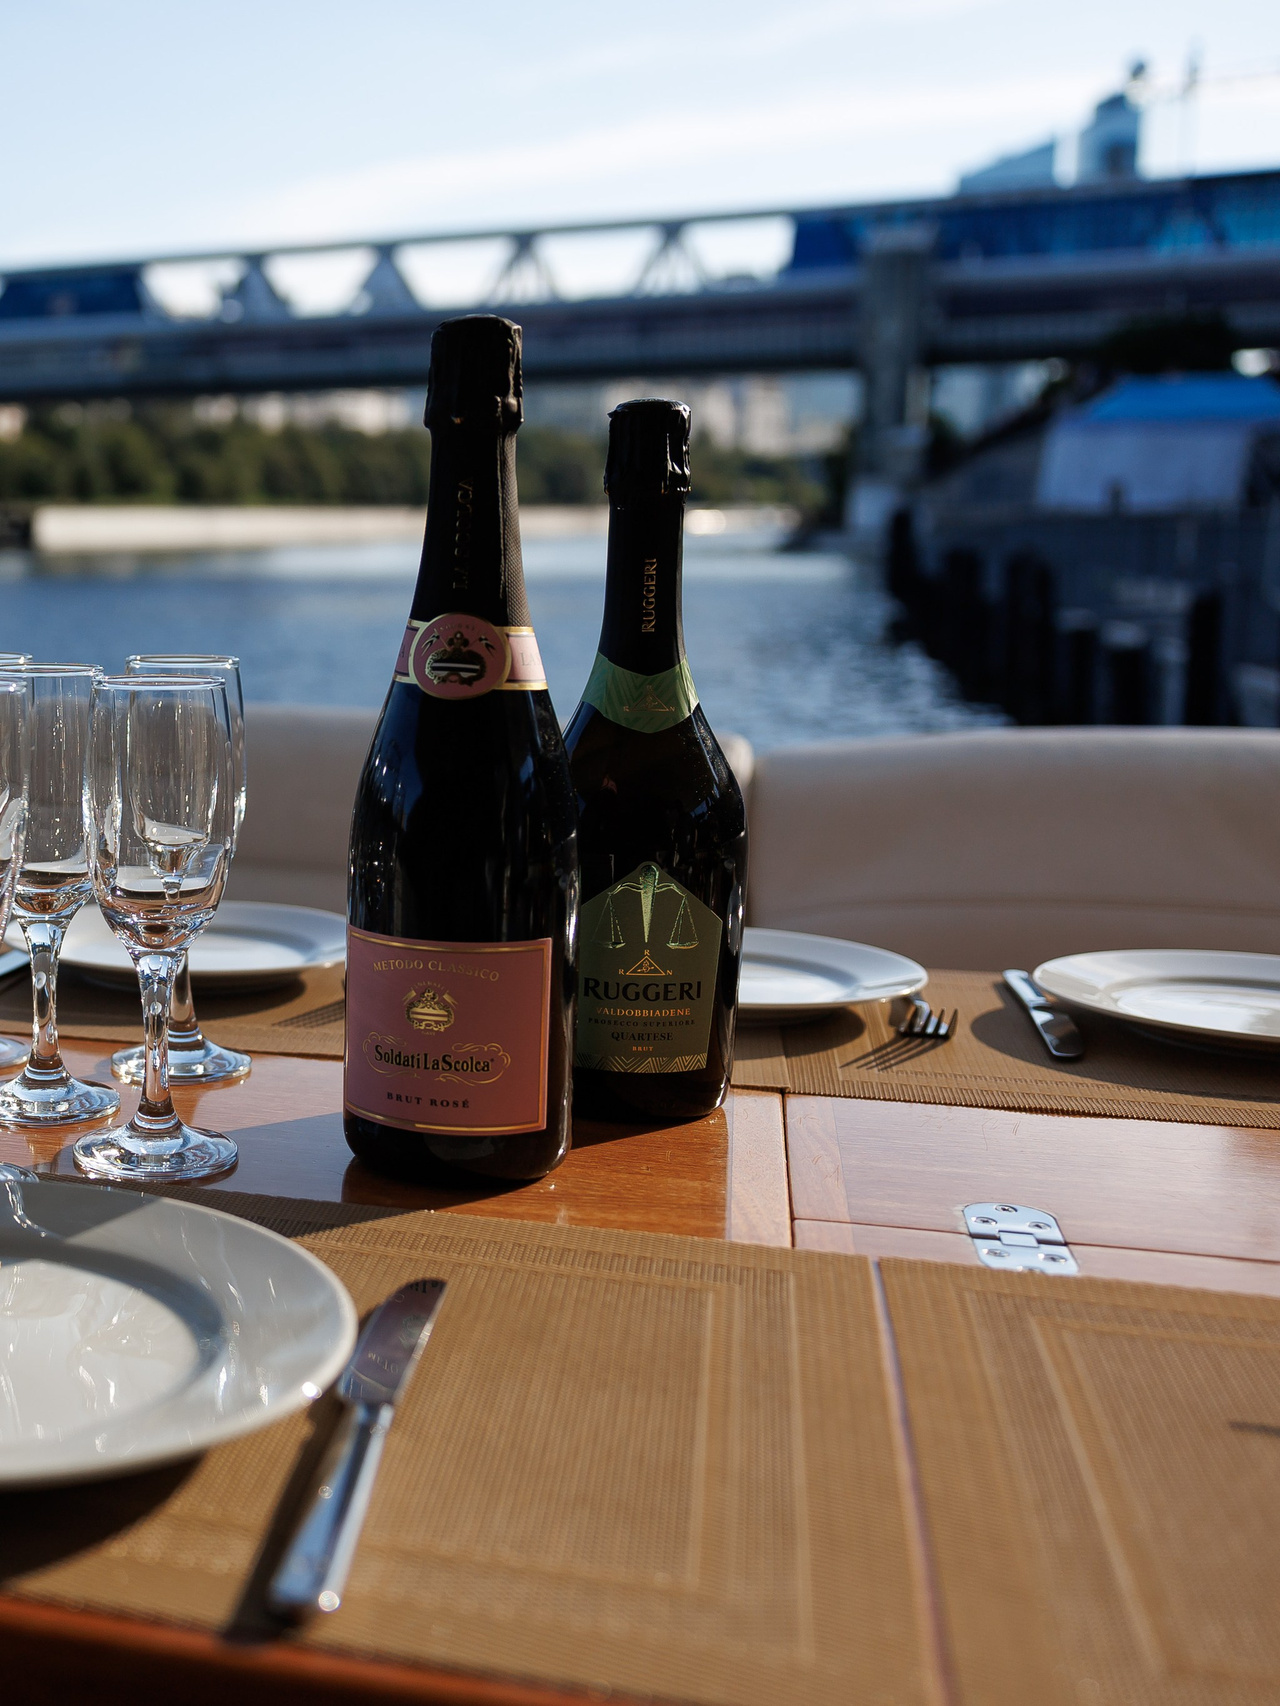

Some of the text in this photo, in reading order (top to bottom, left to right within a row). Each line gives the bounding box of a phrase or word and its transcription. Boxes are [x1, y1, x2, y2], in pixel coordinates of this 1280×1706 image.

[641, 558, 658, 633] RUGGERI
[373, 959, 500, 982] METODO CLASSICO
[618, 968, 625, 976] R
[583, 977, 702, 1002] RUGGERI
[596, 1007, 692, 1017] VALDOBBIADENE
[588, 1017, 696, 1027] PROSECCO SUPERIORE
[611, 1031, 674, 1042] QUARTESE
[374, 1044, 421, 1069] Soldati
[386, 1091, 470, 1109] BRUT ROSÉ
